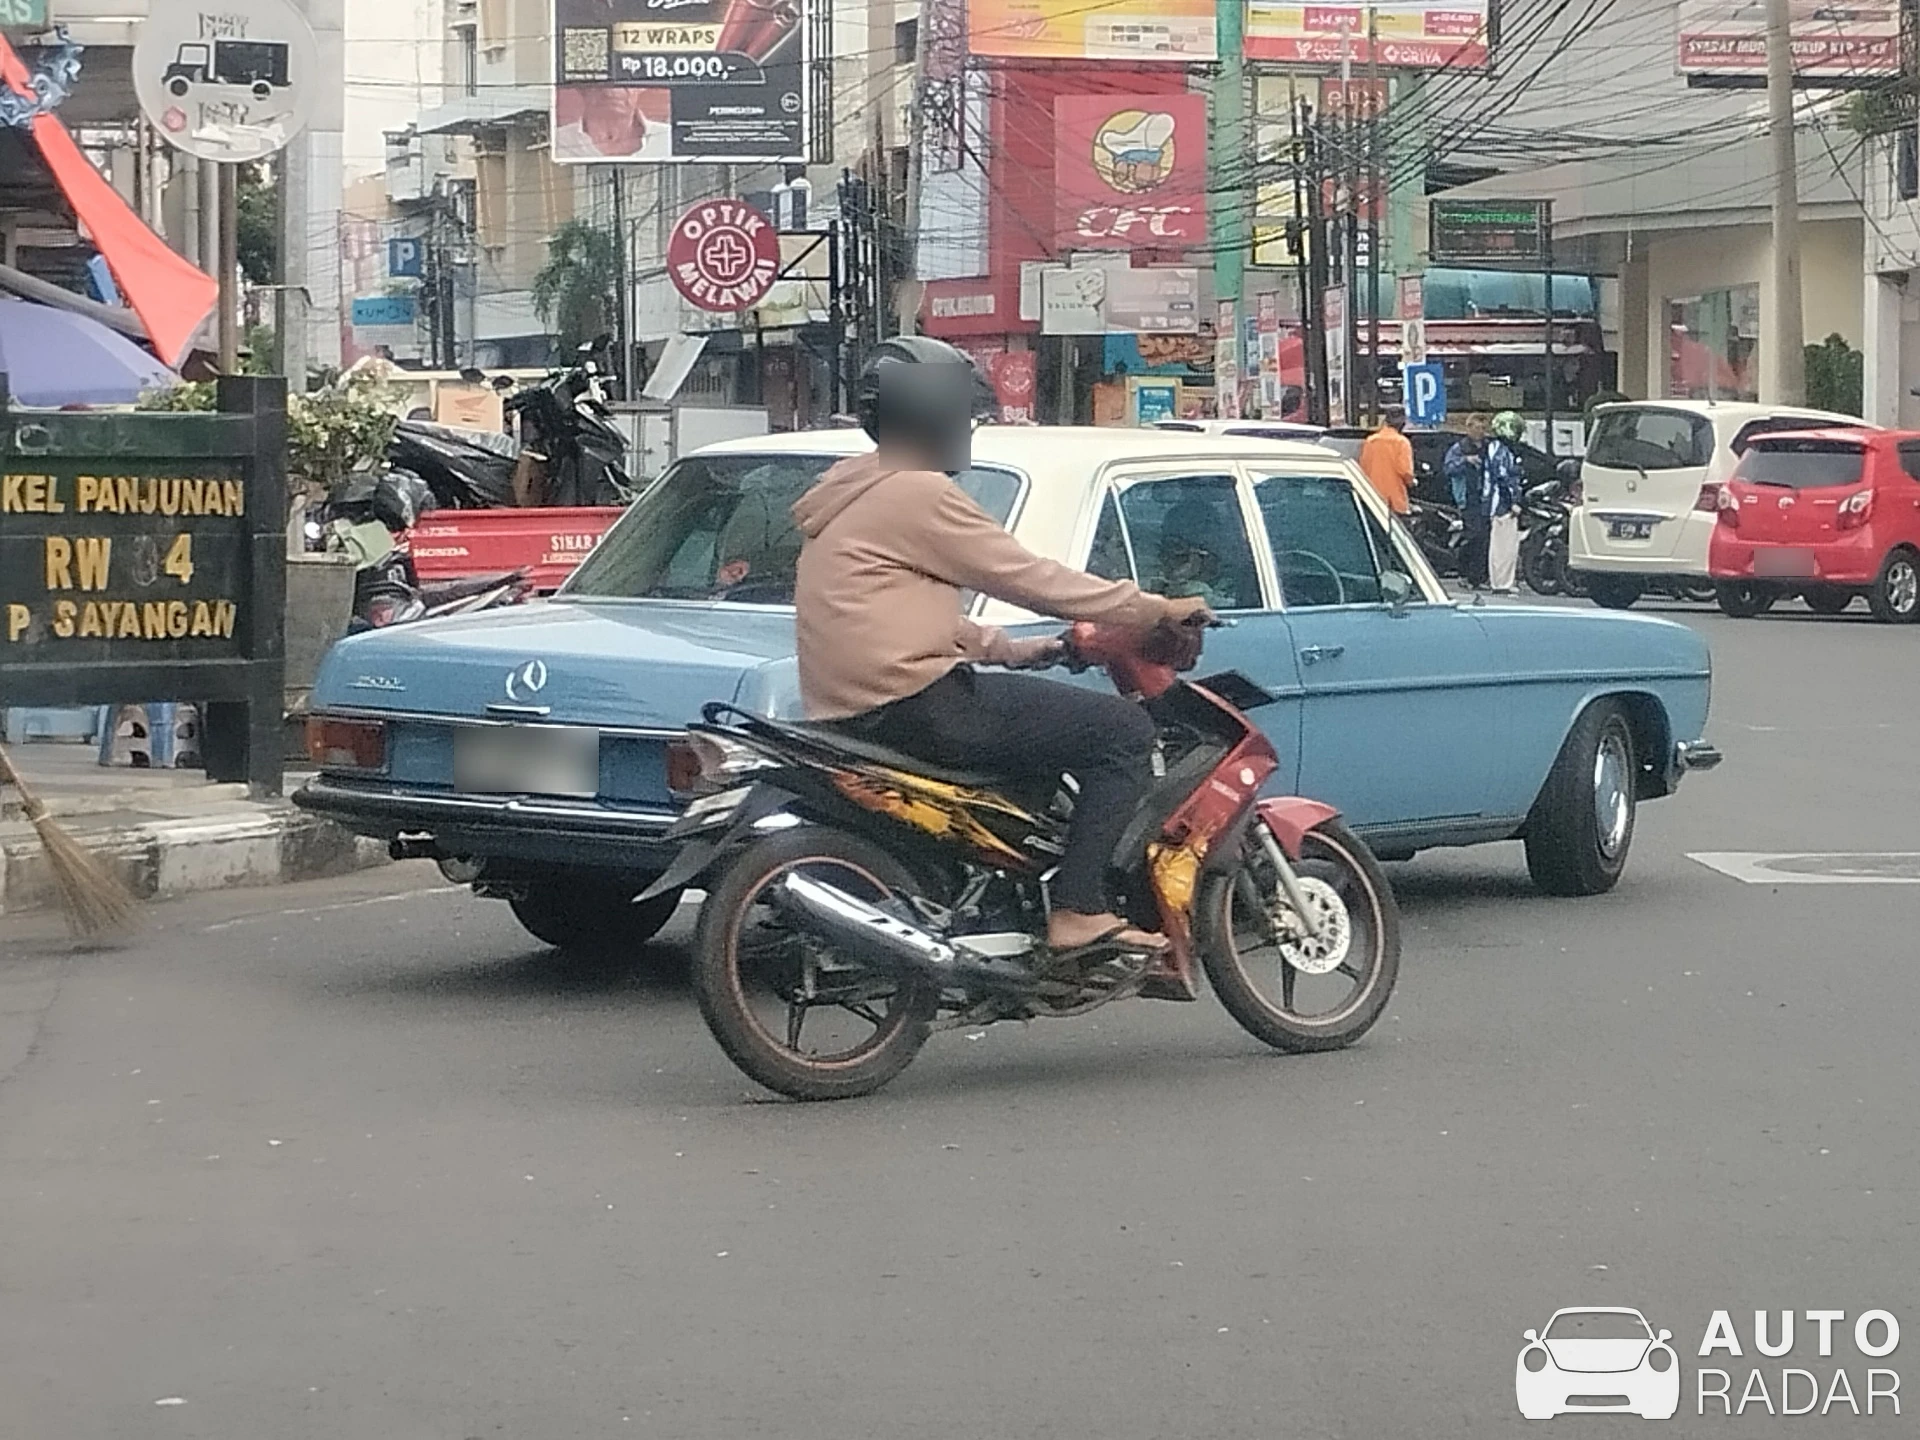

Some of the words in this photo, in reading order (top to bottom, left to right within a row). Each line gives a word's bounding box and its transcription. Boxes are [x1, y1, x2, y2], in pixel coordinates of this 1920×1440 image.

[622, 30, 640, 44] 12
[648, 30, 715, 45] WRAPS
[622, 57, 641, 74] Rp
[683, 205, 765, 239] OPTIK
[1076, 206, 1192, 237] CFC
[396, 241, 415, 271] P
[676, 259, 776, 306] MELAWAI
[1415, 372, 1437, 416] P
[2, 475, 65, 513] KEL
[77, 476, 245, 517] PANJUNAN
[551, 535, 592, 551] SINAR
[46, 536, 112, 591] RW
[53, 600, 237, 639] SAYANGAN
